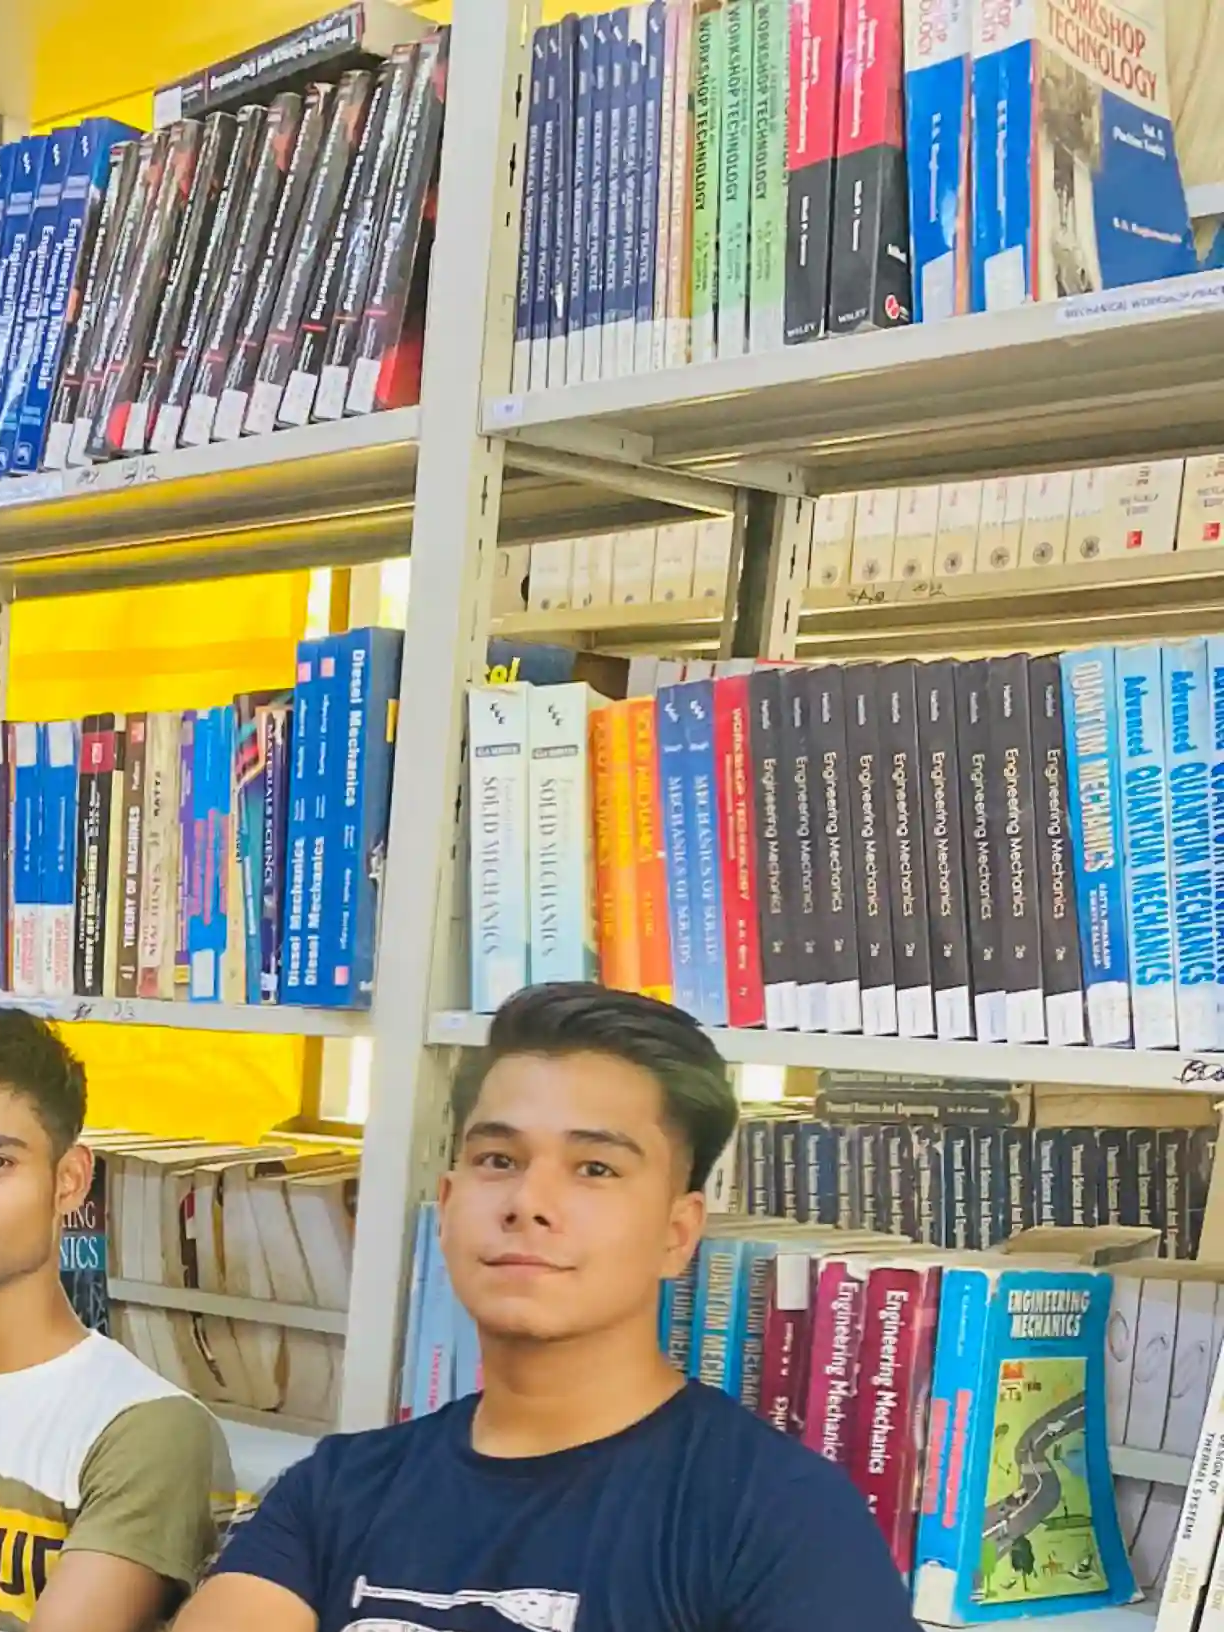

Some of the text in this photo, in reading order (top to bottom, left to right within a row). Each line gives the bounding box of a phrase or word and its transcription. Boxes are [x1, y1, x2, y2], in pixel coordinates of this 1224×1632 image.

[694, 16, 713, 211] WORKSHOP TECHNOLOGY
[725, 5, 742, 203] WORKSHOP TECHNOLOGY
[754, 4, 771, 201] WORKSHOP TECHNOLOGY
[1045, 8, 1158, 103] TECHNOLOGY
[311, 86, 383, 321] Materials Science and Engineering
[38, 217, 82, 390] Engineering Materials
[786, 322, 816, 337] WILEY
[837, 307, 867, 324] WILEY
[263, 723, 275, 886] MATERIALS SCIENCE
[344, 649, 366, 807] Diesel Mechanics
[1069, 660, 1114, 875] QUANTUM MECHANICS
[124, 878, 137, 895] OF
[125, 805, 141, 876] MACHINES
[480, 775, 502, 956] SOLID MECHANICS
[538, 777, 559, 958] SOLID MECHANICS
[664, 775, 688, 872] MECHANICS
[694, 774, 713, 868] MECHANICS
[761, 757, 782, 915] Engineering Mechanics
[794, 755, 813, 915] Engineering Mechanics
[822, 751, 843, 913] Engineering Mechanics
[858, 753, 879, 917] Engineering Mechanics
[891, 752, 915, 917] Engineering Mechanics
[930, 751, 951, 917] Engineering Mechanics
[970, 753, 992, 921] Engineering Mechanics
[1003, 748, 1025, 918] Engineering Mechanics
[1044, 749, 1066, 920] Engineering Mechanics
[1123, 674, 1173, 988] Advanced QUANTUM MECHANICS
[1170, 670, 1216, 988] Advanced QUANTUM MECHANICS
[122, 899, 136, 949] THEORY
[287, 836, 307, 988] Diesel Mechanics
[304, 836, 325, 986] Diesel Mechanics
[706, 1252, 734, 1330] QUANTUM
[824, 1280, 860, 1378] Engineering
[1007, 1288, 1093, 1314] ENGINEERING
[1009, 1312, 1082, 1340] MECHANICS
[867, 1289, 909, 1475] Engineering Mechanics
[1181, 1431, 1216, 1541] THERMAL SYSTEMS
